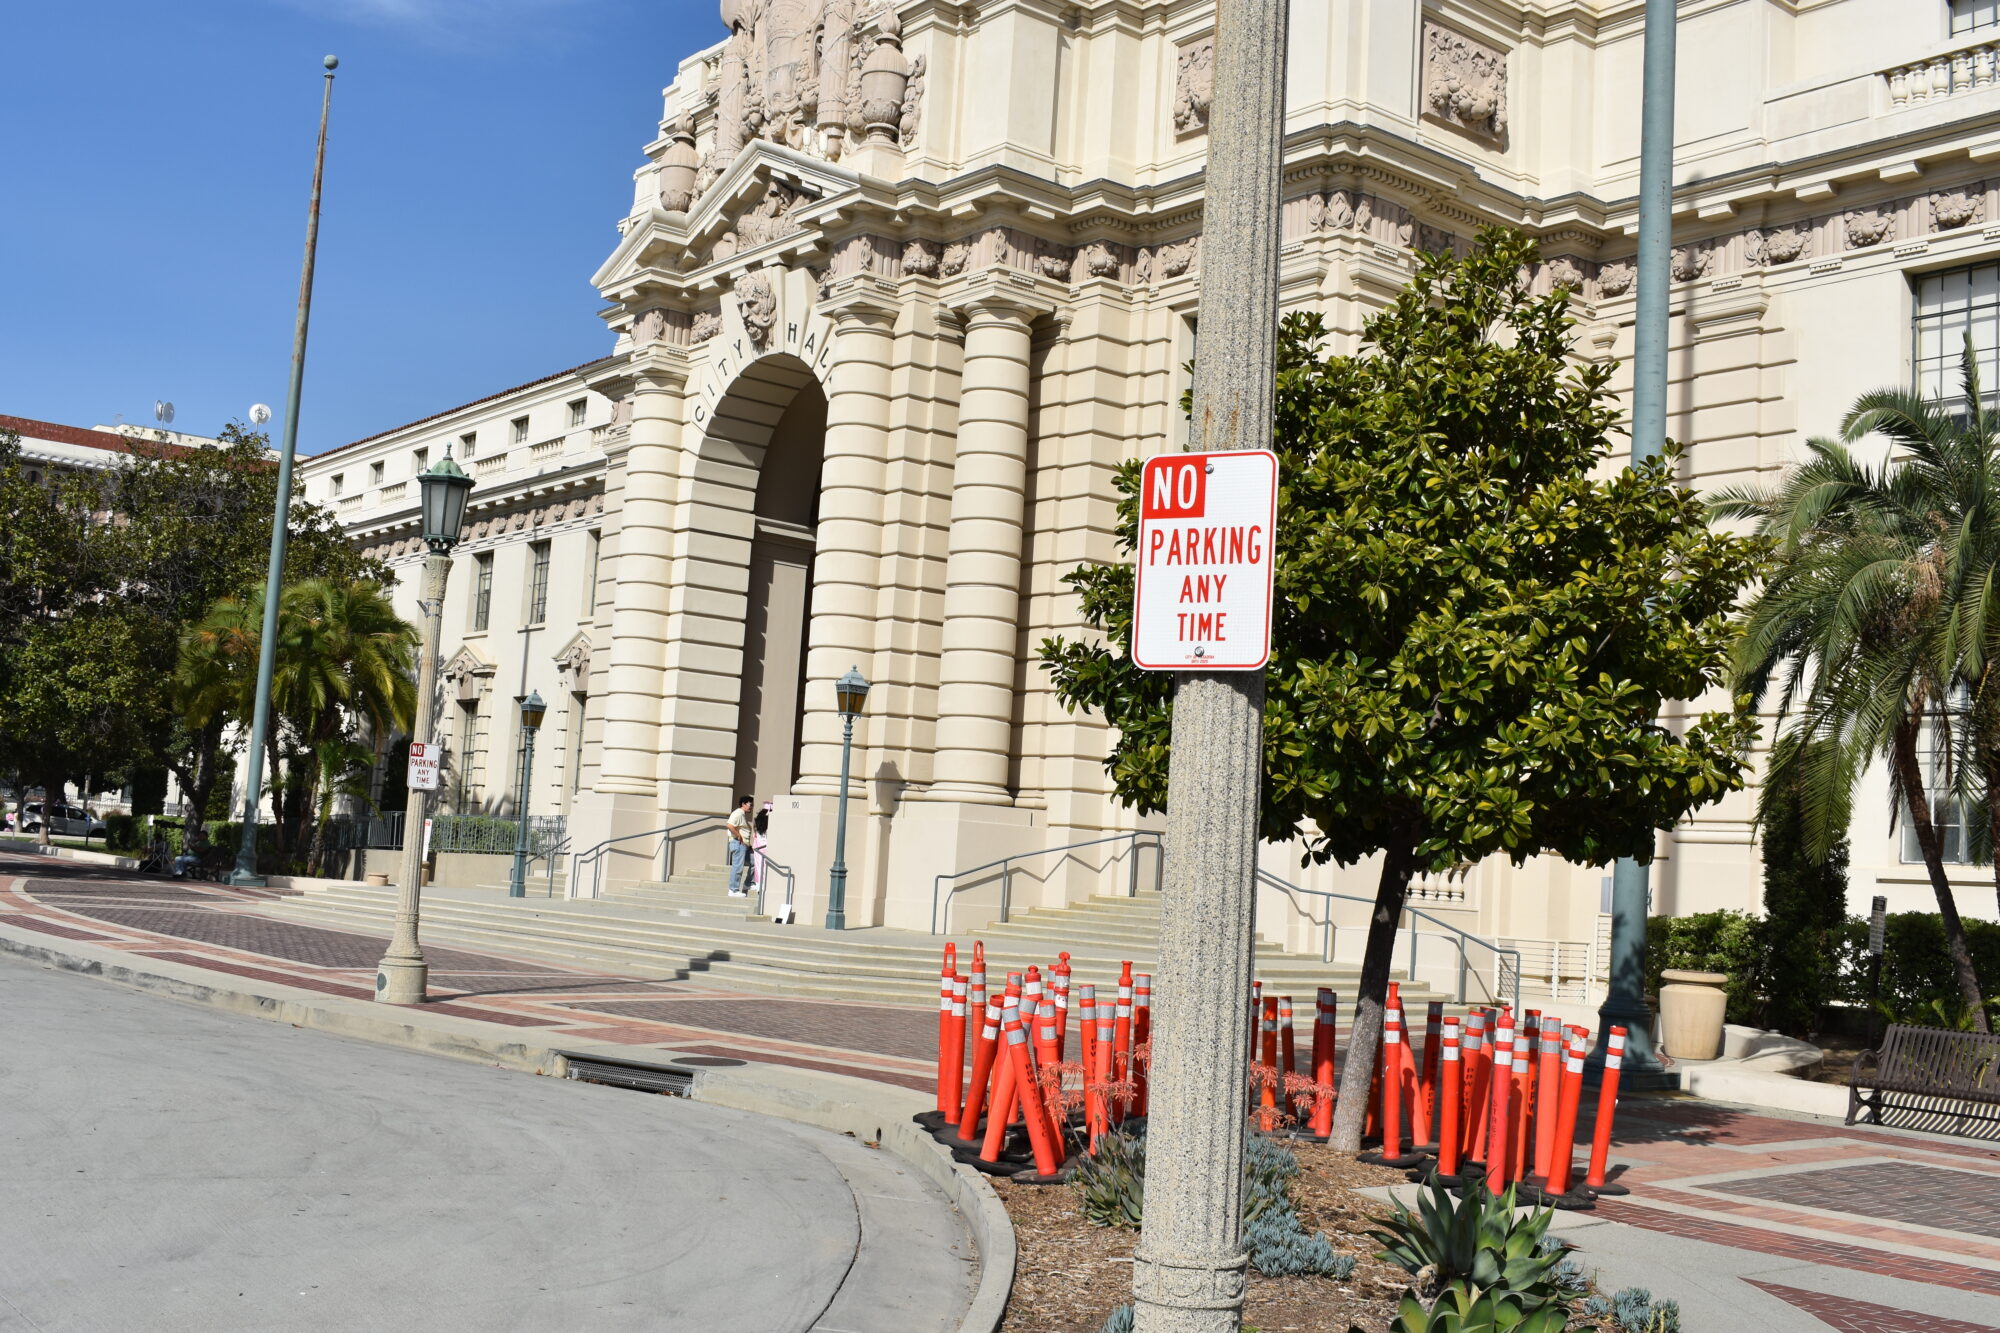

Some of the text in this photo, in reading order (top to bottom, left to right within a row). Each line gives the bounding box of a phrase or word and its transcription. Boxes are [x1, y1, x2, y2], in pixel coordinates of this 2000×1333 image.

[695, 322, 832, 422] CITY HAL
[1152, 464, 1198, 510] NO
[1150, 525, 1262, 566] PARKING
[1179, 574, 1227, 603] ANY
[1177, 613, 1227, 641] TIME
[411, 758, 437, 768] PARKING
[412, 745, 423, 755] NO
